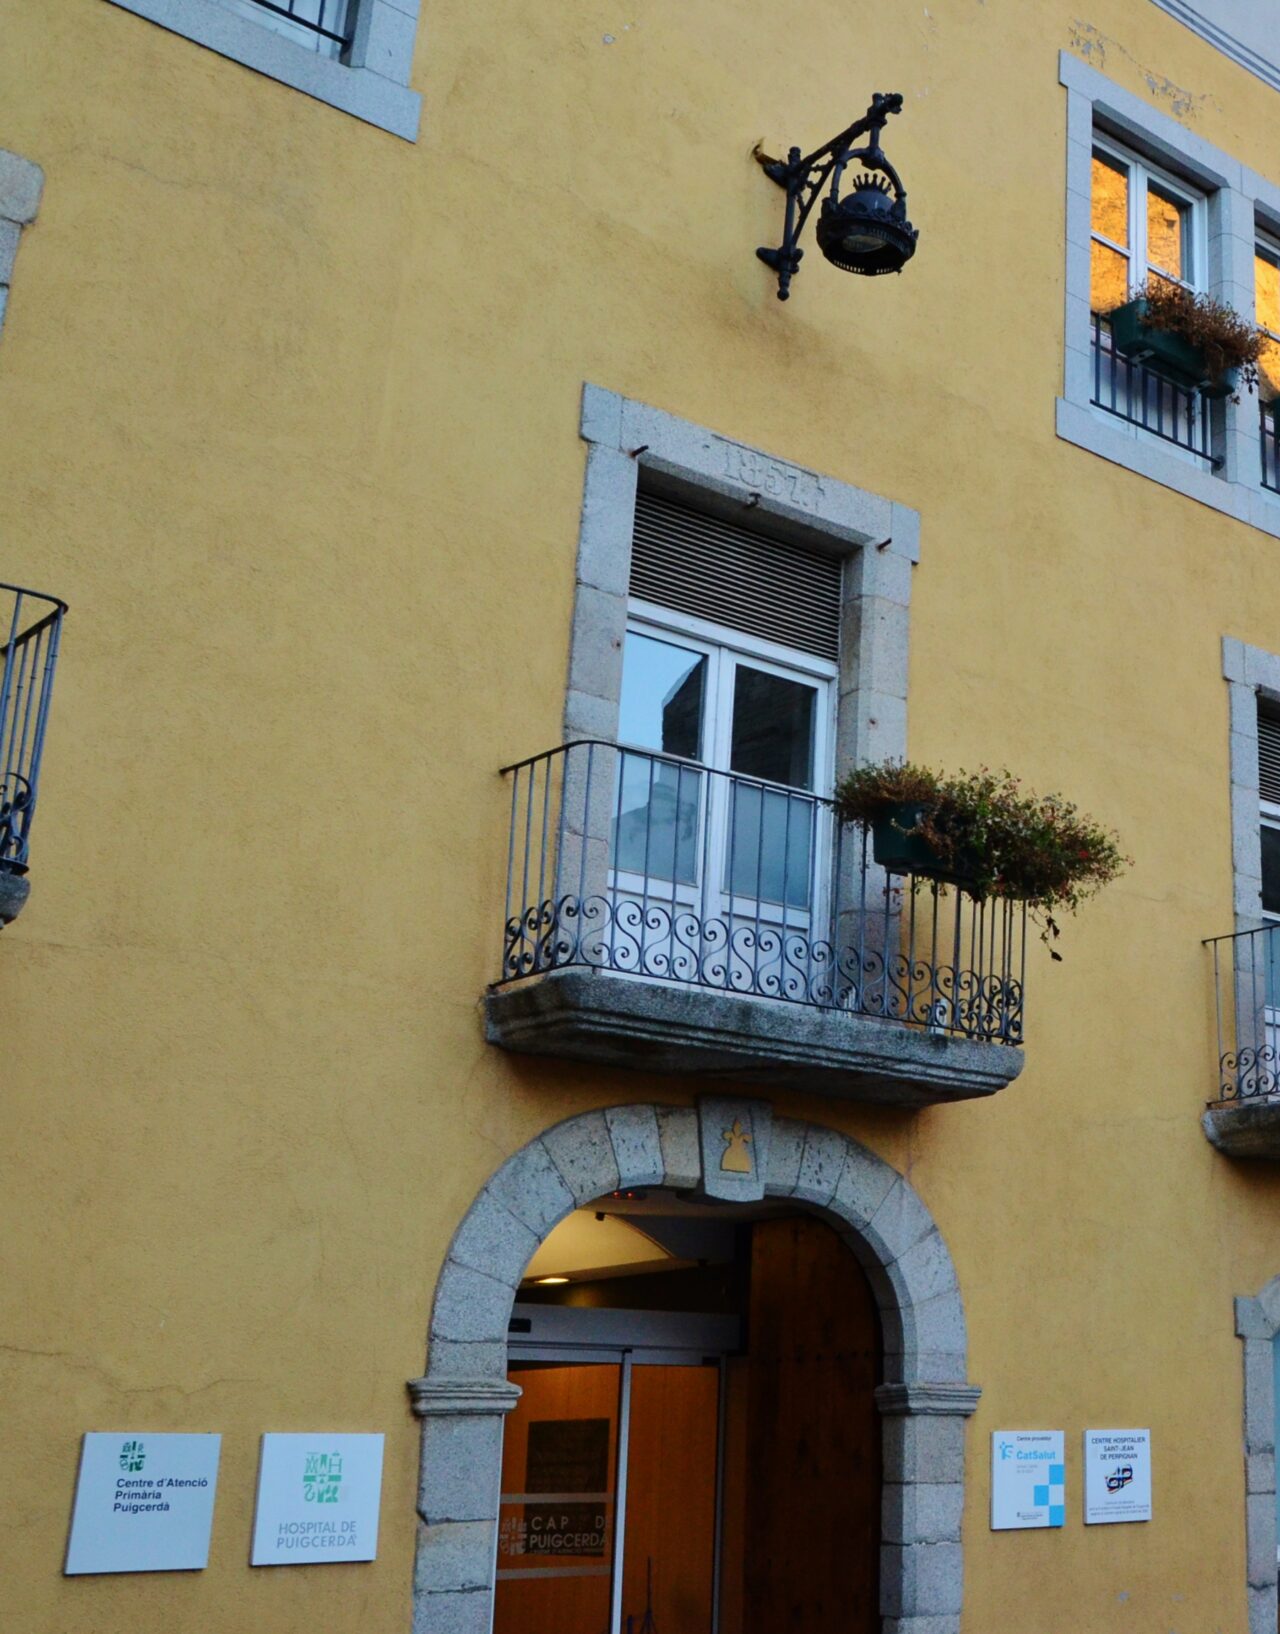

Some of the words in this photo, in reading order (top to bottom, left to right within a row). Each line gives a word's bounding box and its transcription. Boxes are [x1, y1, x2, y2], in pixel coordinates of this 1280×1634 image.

[1091, 1437, 1112, 1445] CENTRE
[1016, 1450, 1056, 1460] CatSalut
[116, 1478, 154, 1488] Centre
[156, 1476, 208, 1488] d'Atenció
[115, 1490, 162, 1500] Primària
[113, 1502, 170, 1514] Puigcerdà
[279, 1521, 337, 1535] HOSPITAL
[341, 1520, 357, 1533] DE
